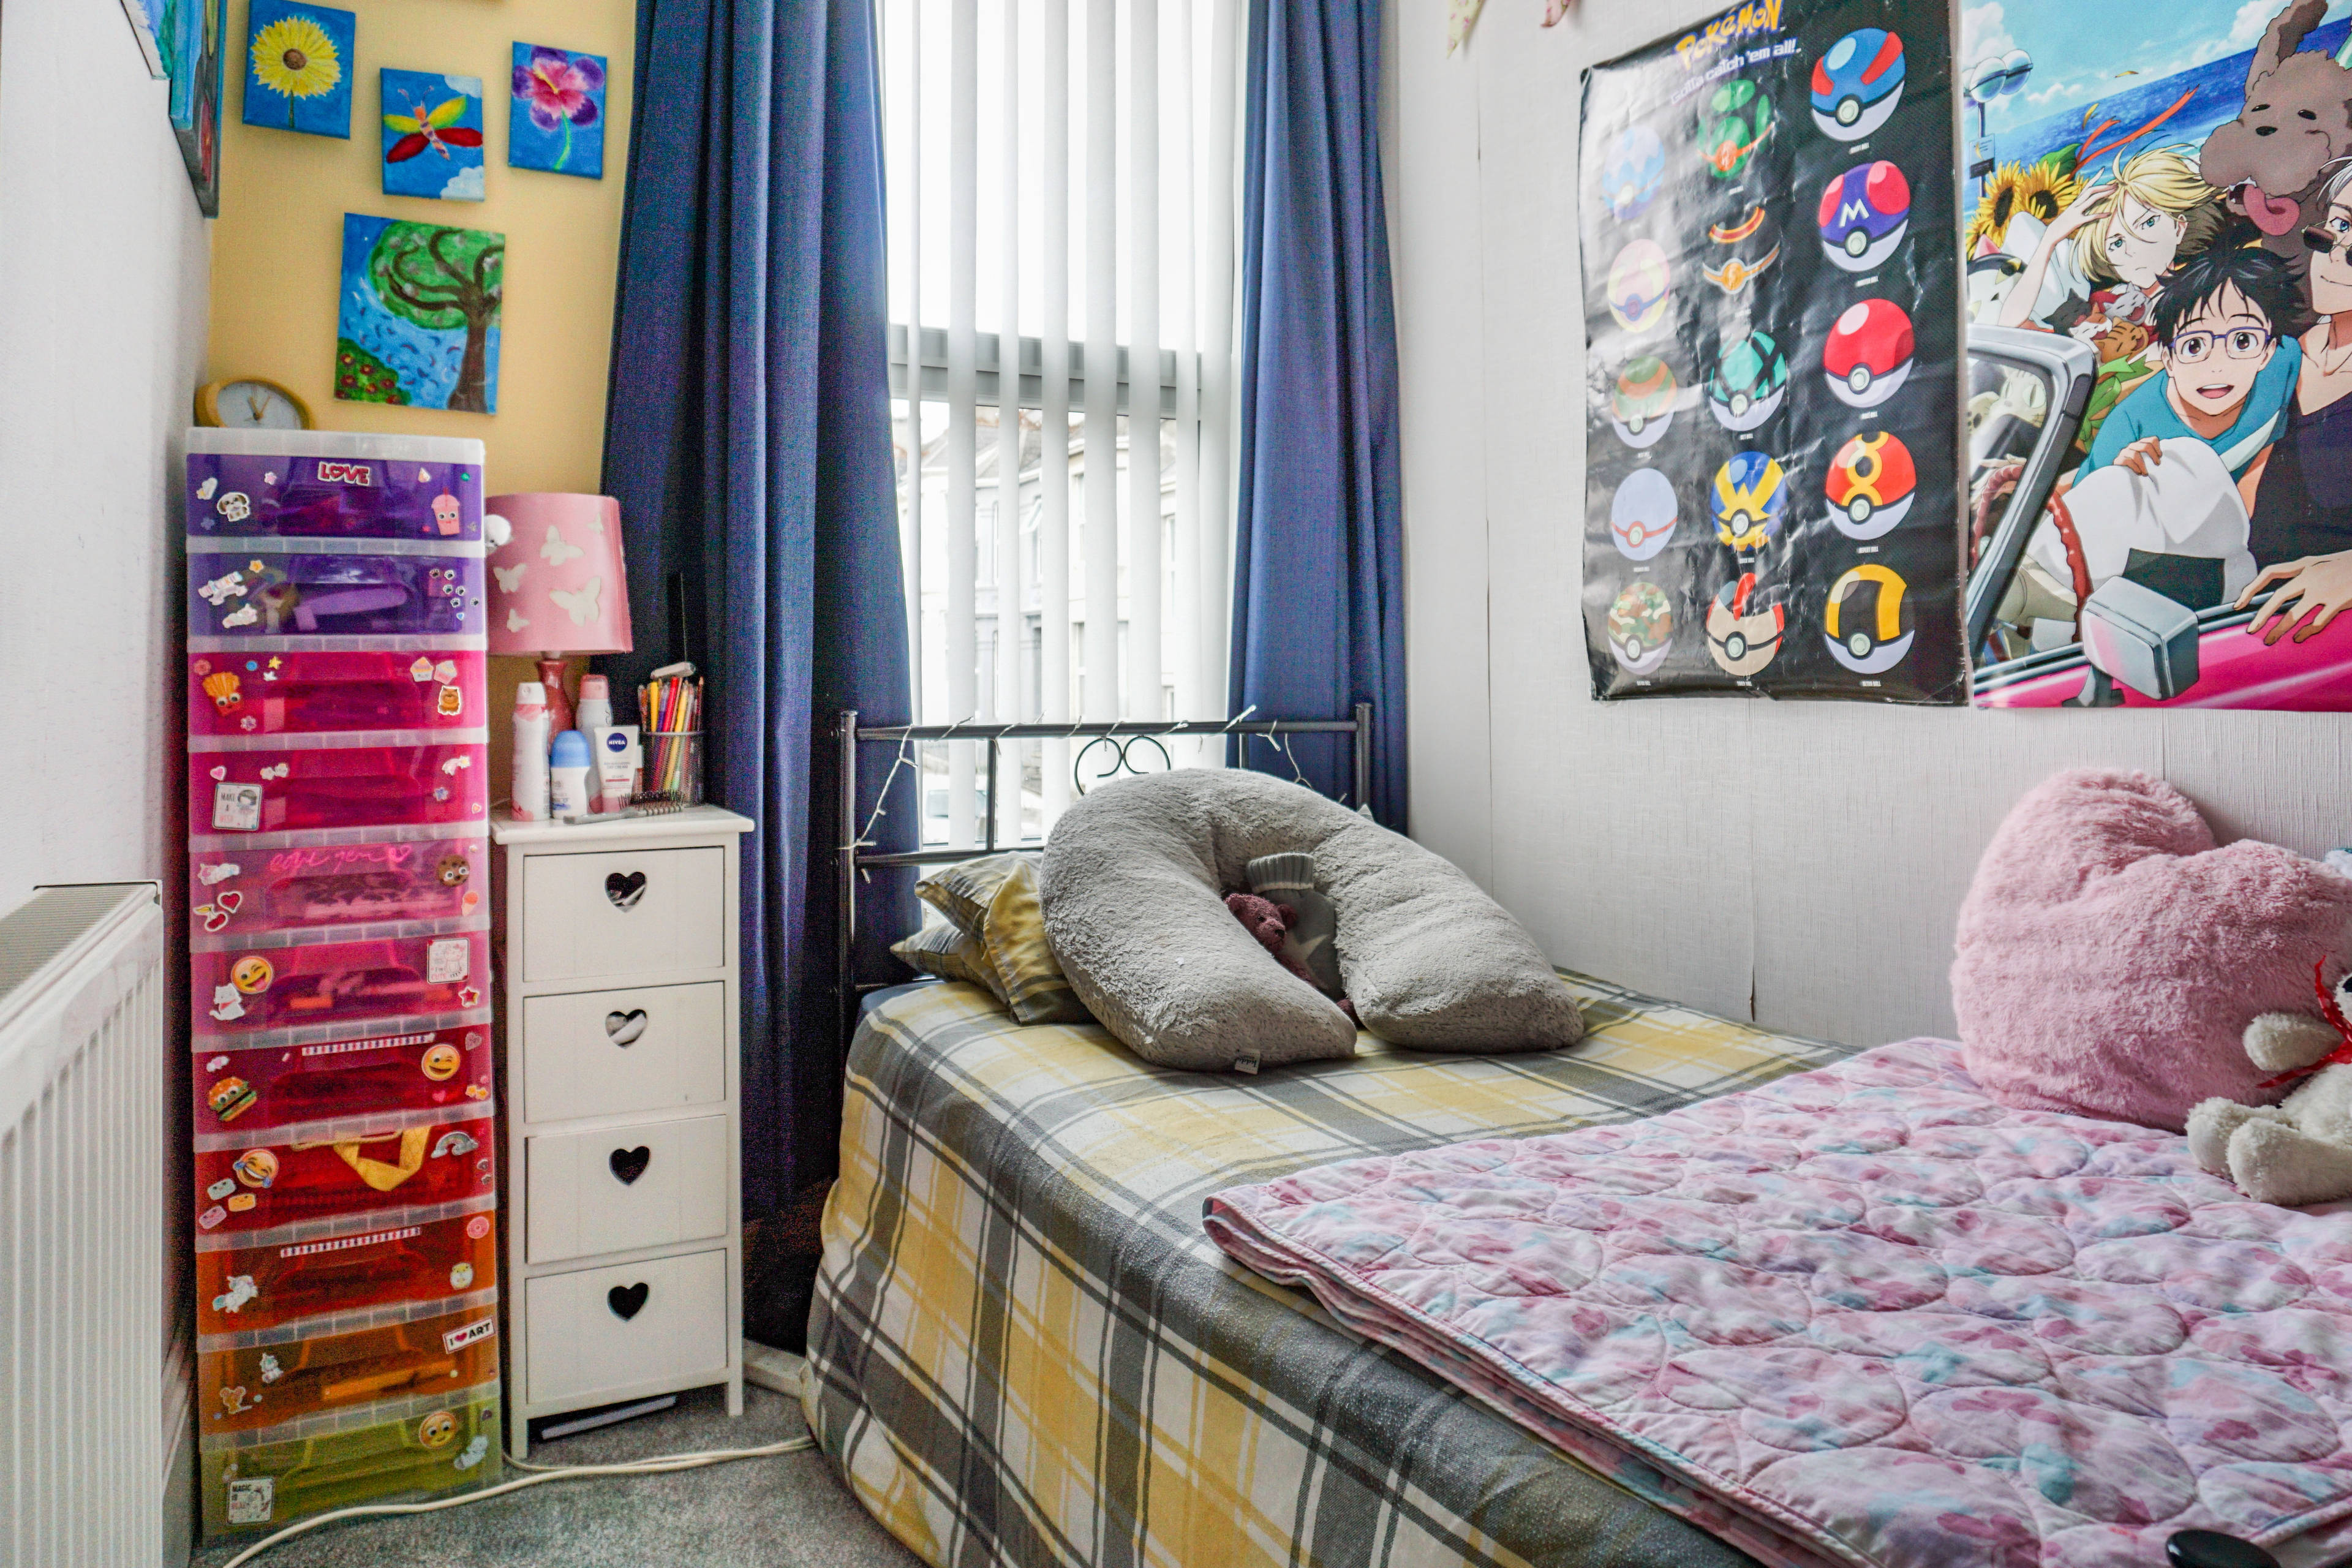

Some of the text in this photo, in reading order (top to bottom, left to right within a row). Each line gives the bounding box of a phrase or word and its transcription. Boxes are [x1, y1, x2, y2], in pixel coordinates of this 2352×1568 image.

[1839, 198, 1869, 228] M
[319, 462, 370, 485] LOVE
[469, 1322, 491, 1340] ART
